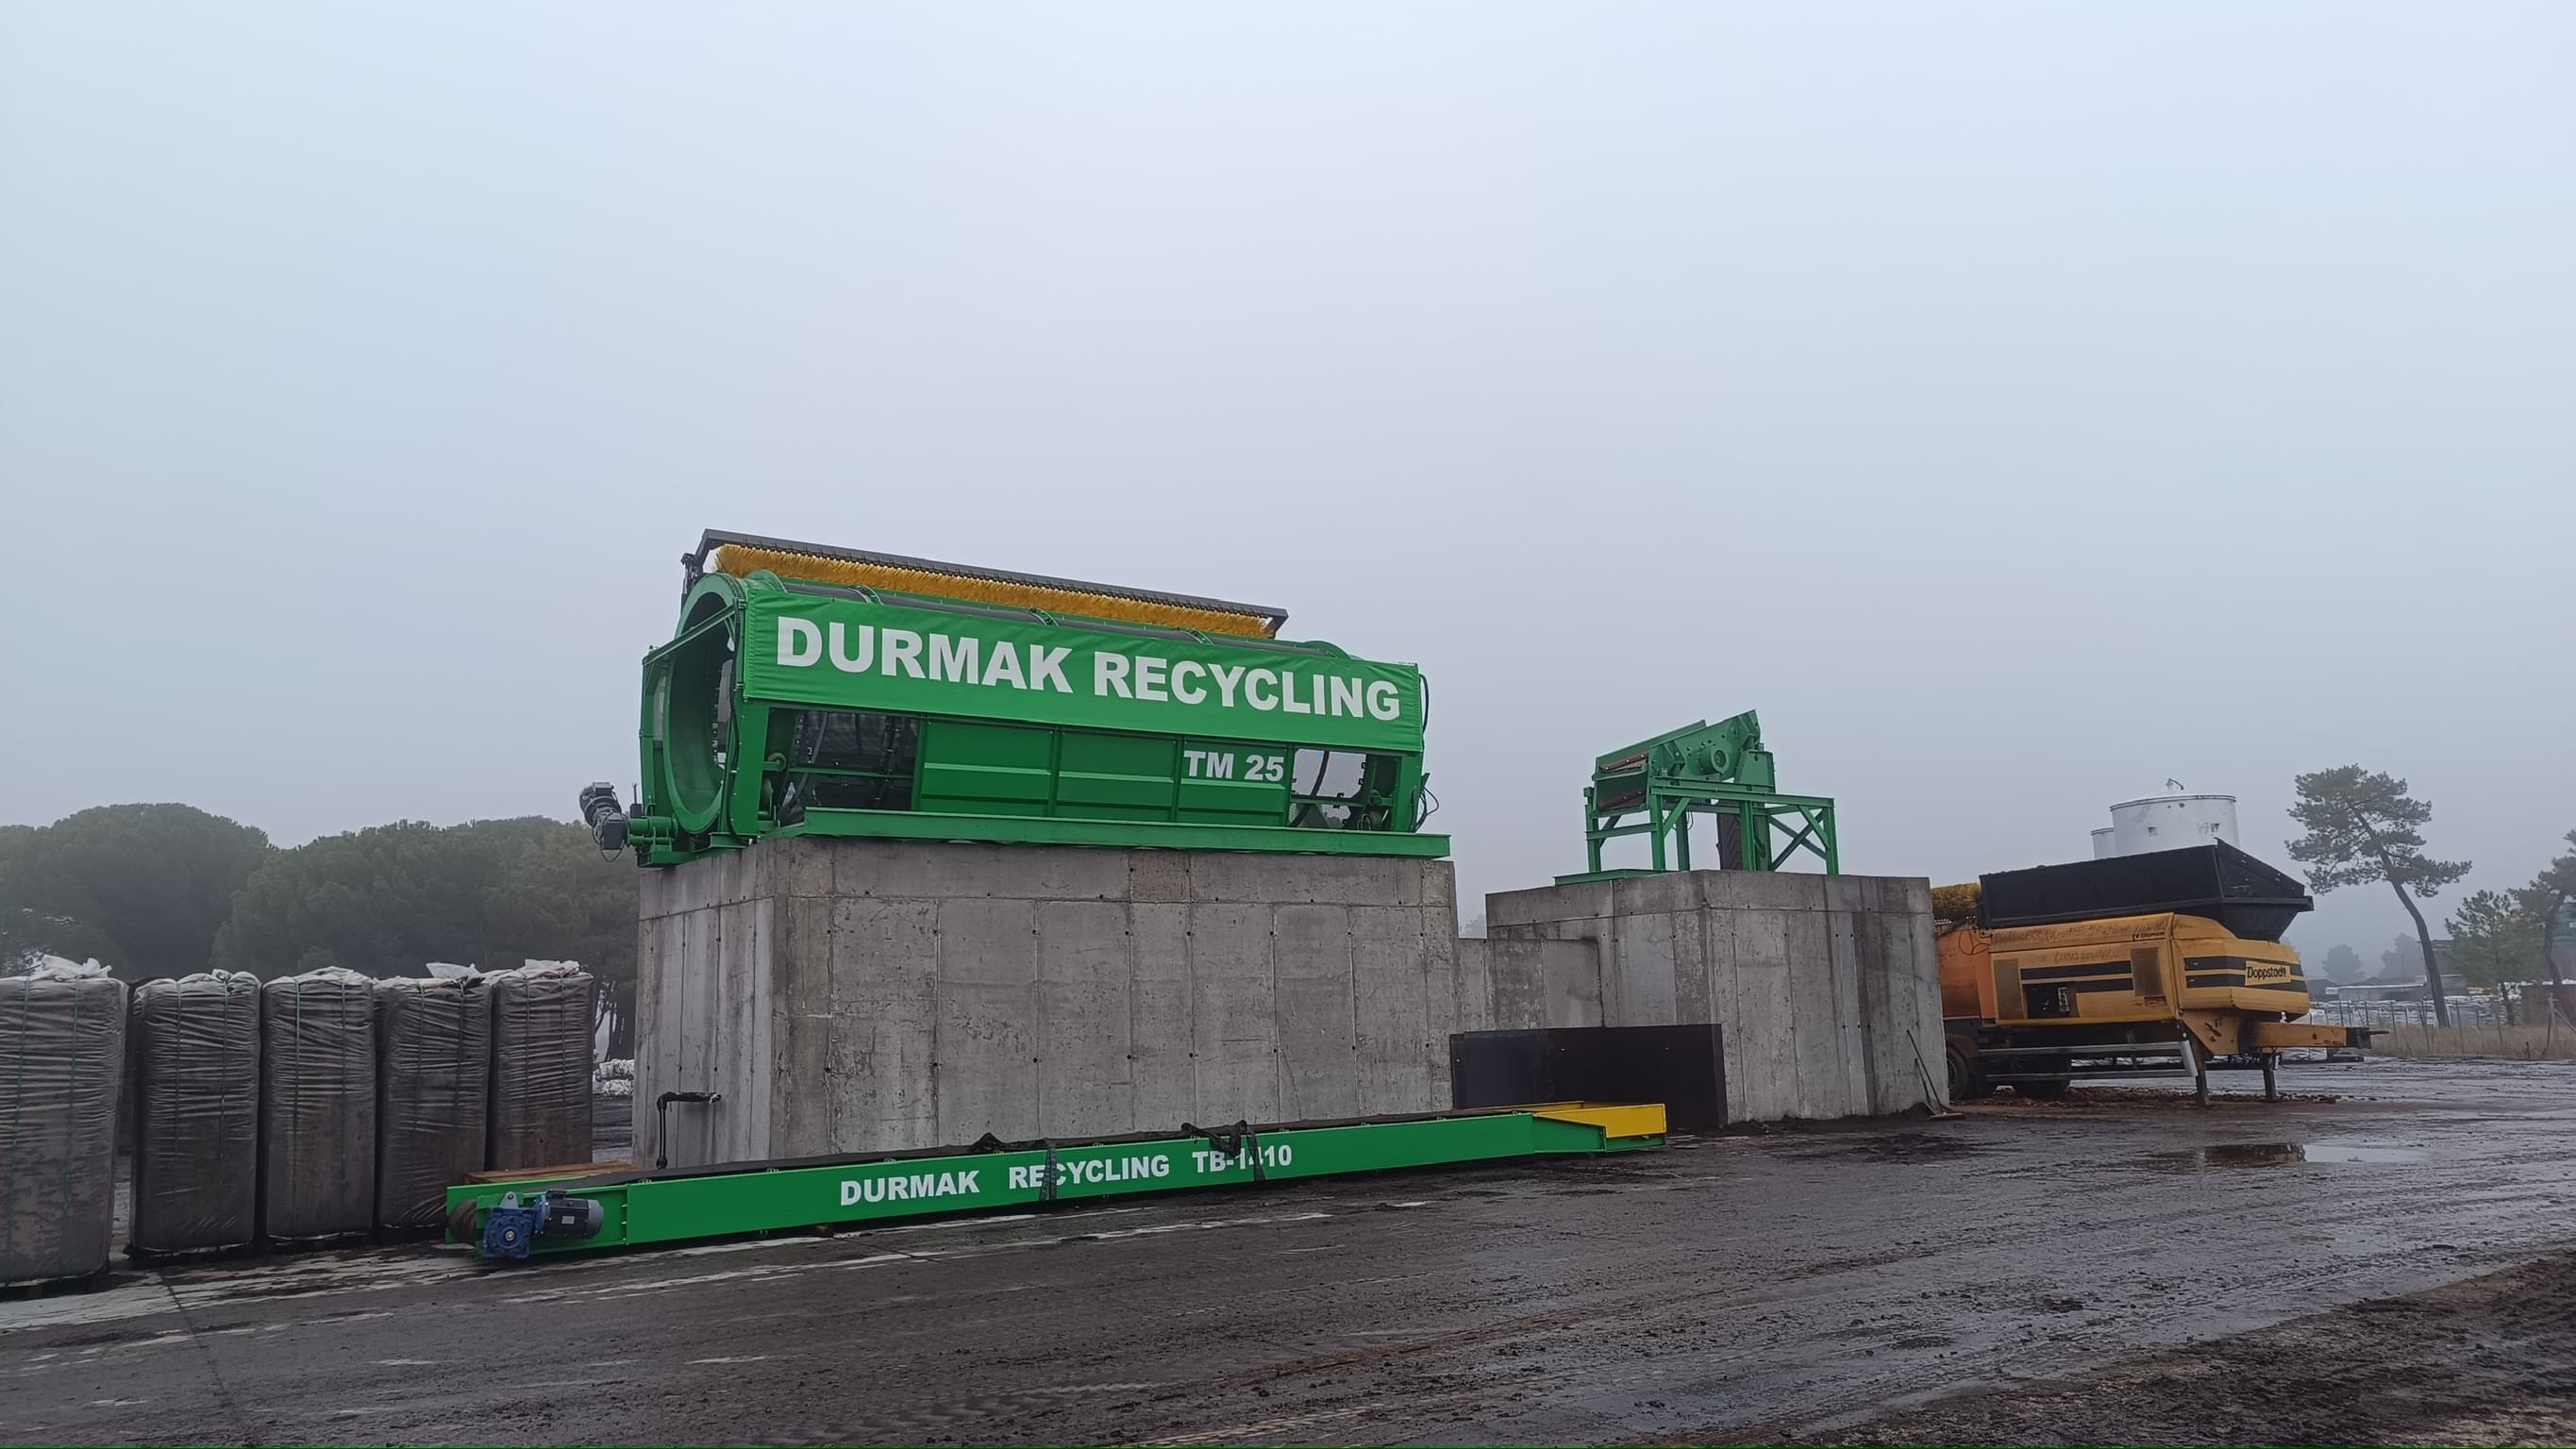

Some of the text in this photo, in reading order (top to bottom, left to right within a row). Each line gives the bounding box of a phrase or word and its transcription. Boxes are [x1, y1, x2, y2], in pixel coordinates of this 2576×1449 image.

[776, 615, 1400, 721] DURMAK RECYCLING
[1183, 751, 1284, 782] TM 25
[840, 1170, 980, 1207] DURMAK
[1009, 1155, 1170, 1190] RECYCLING
